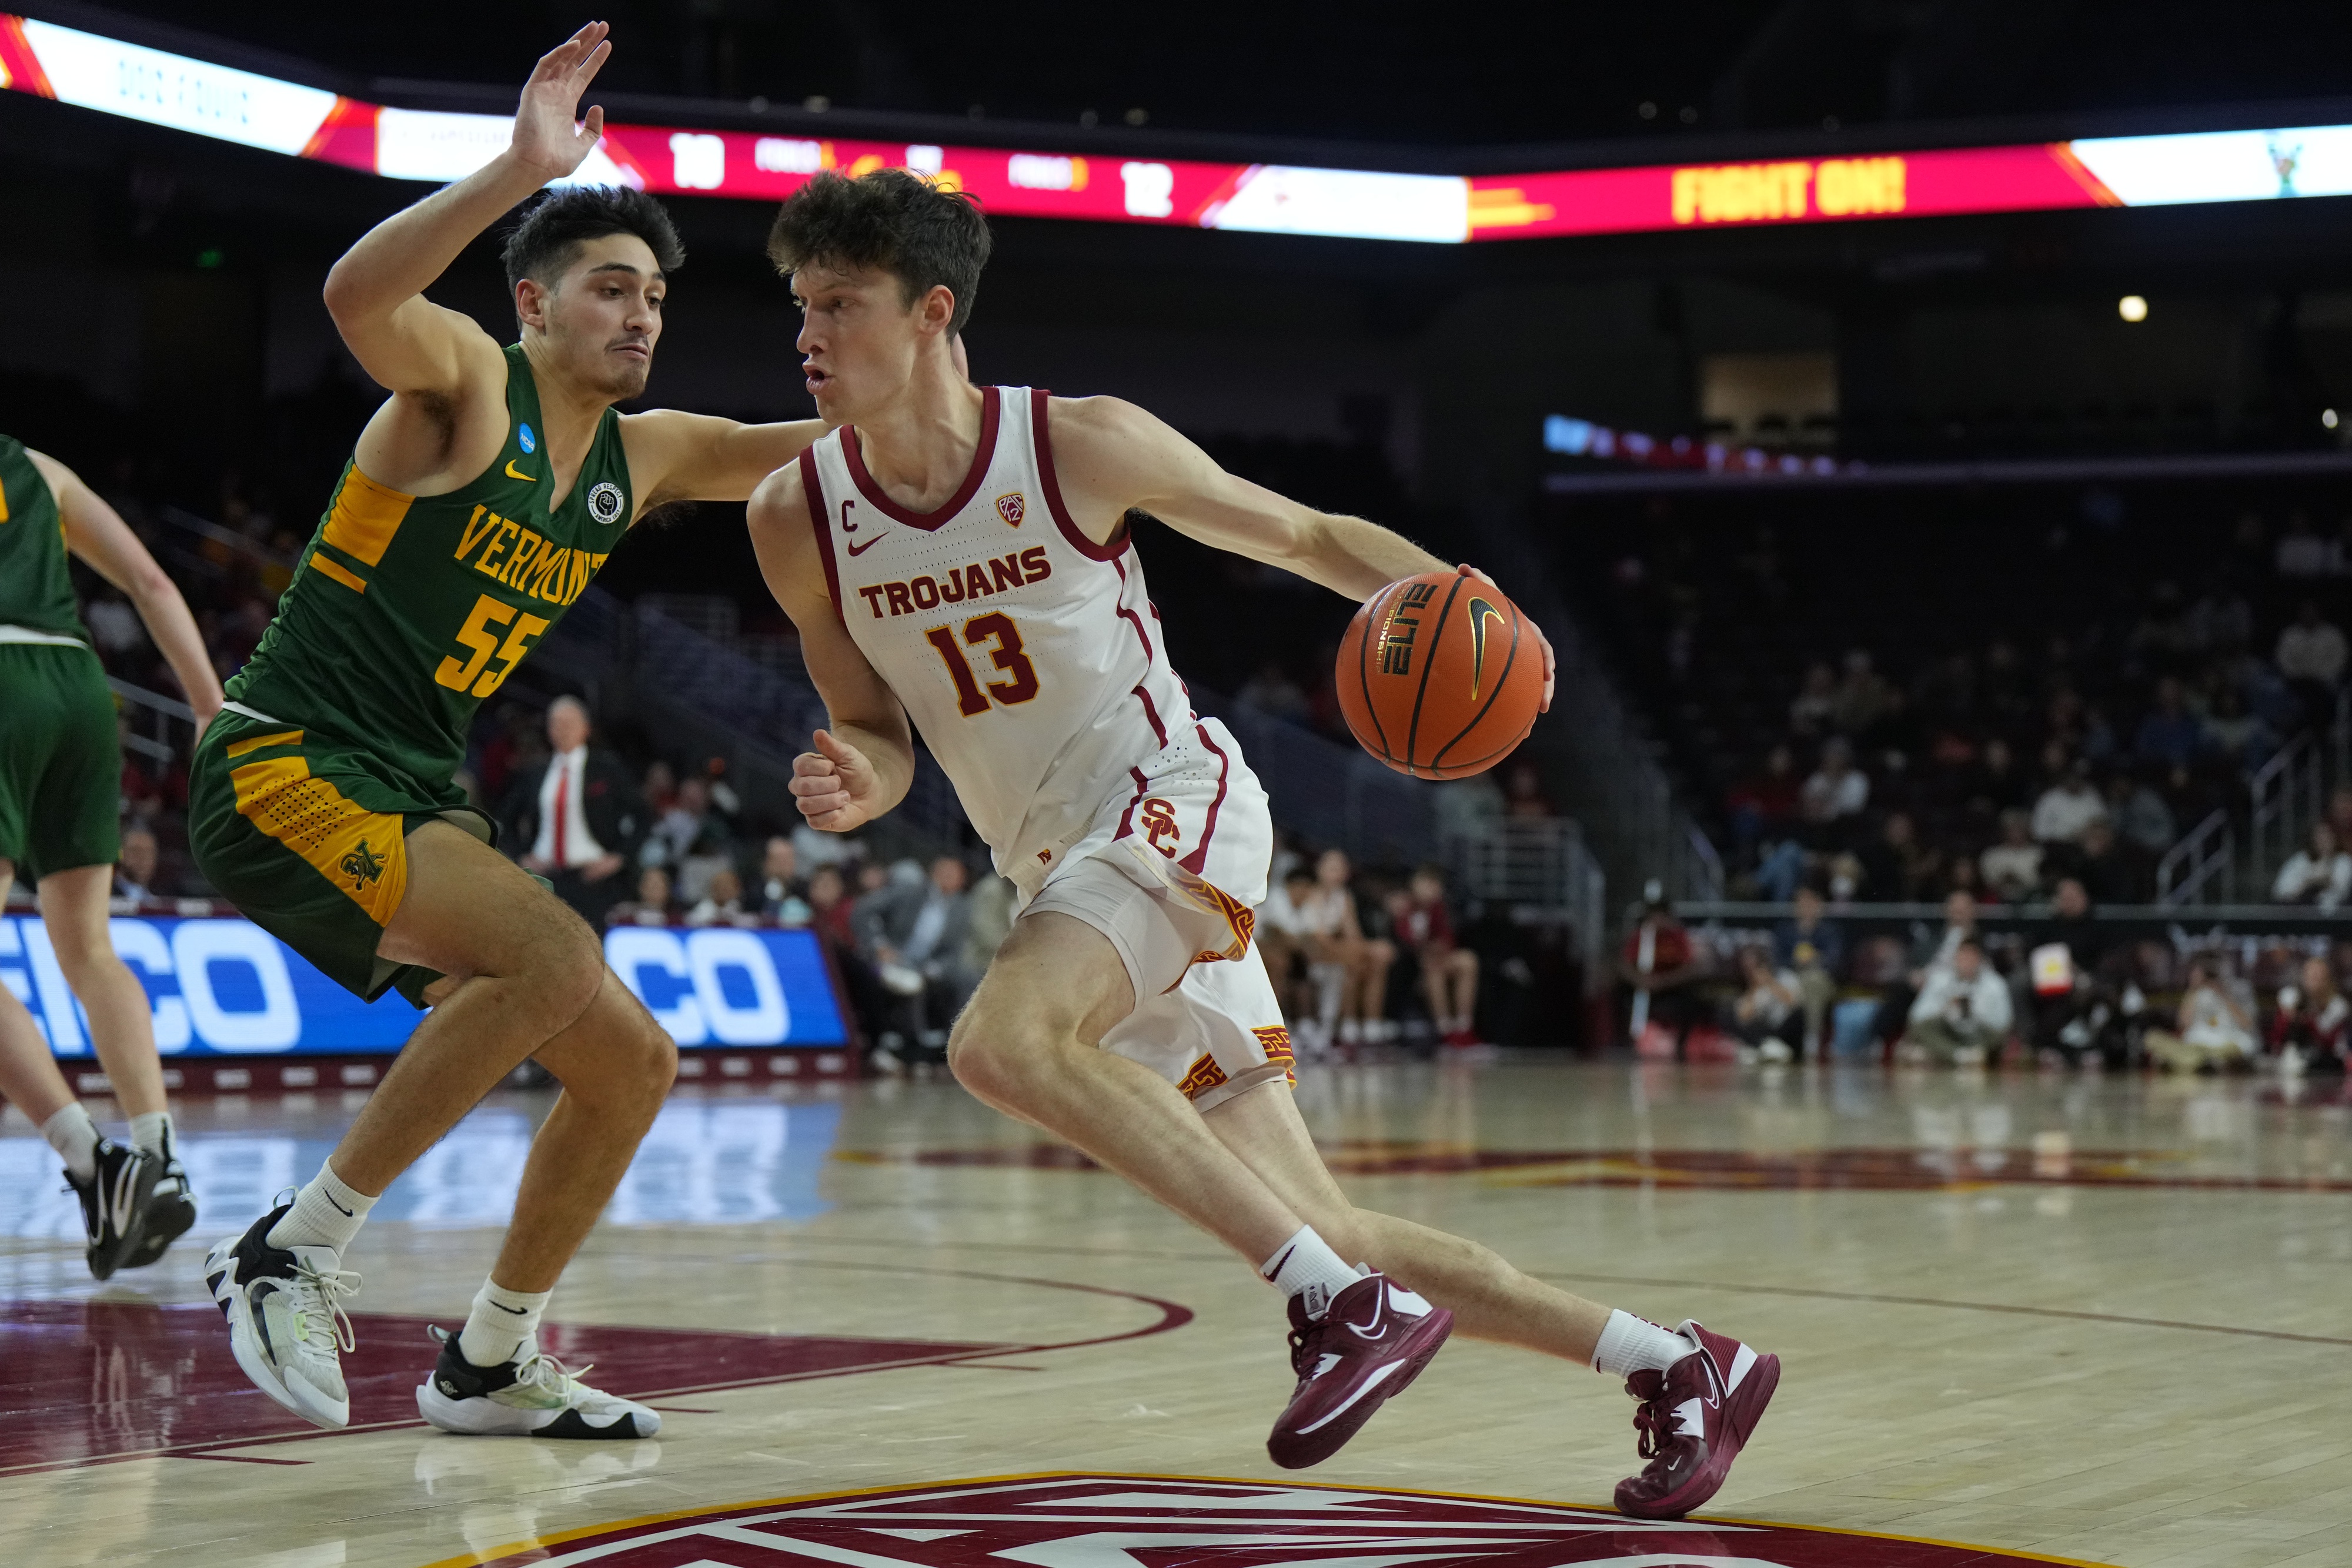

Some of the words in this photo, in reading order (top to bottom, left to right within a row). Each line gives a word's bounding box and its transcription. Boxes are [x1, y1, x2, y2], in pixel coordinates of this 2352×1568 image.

[1671, 162, 1813, 225] FIGHT
[1816, 155, 1906, 216] ON!
[520, 433, 534, 451] NCAA
[589, 484, 602, 504] SPREAD
[603, 483, 623, 499] RESPECT
[998, 494, 1023, 517] PAC
[594, 513, 612, 523] AMERICA
[612, 509, 620, 520] EAST
[841, 500, 858, 532] C
[1006, 507, 1021, 522] 12
[858, 545, 1052, 619] TROJANS
[1382, 582, 1439, 676] ELITE
[435, 594, 551, 698] 55
[924, 610, 1041, 718] 13
